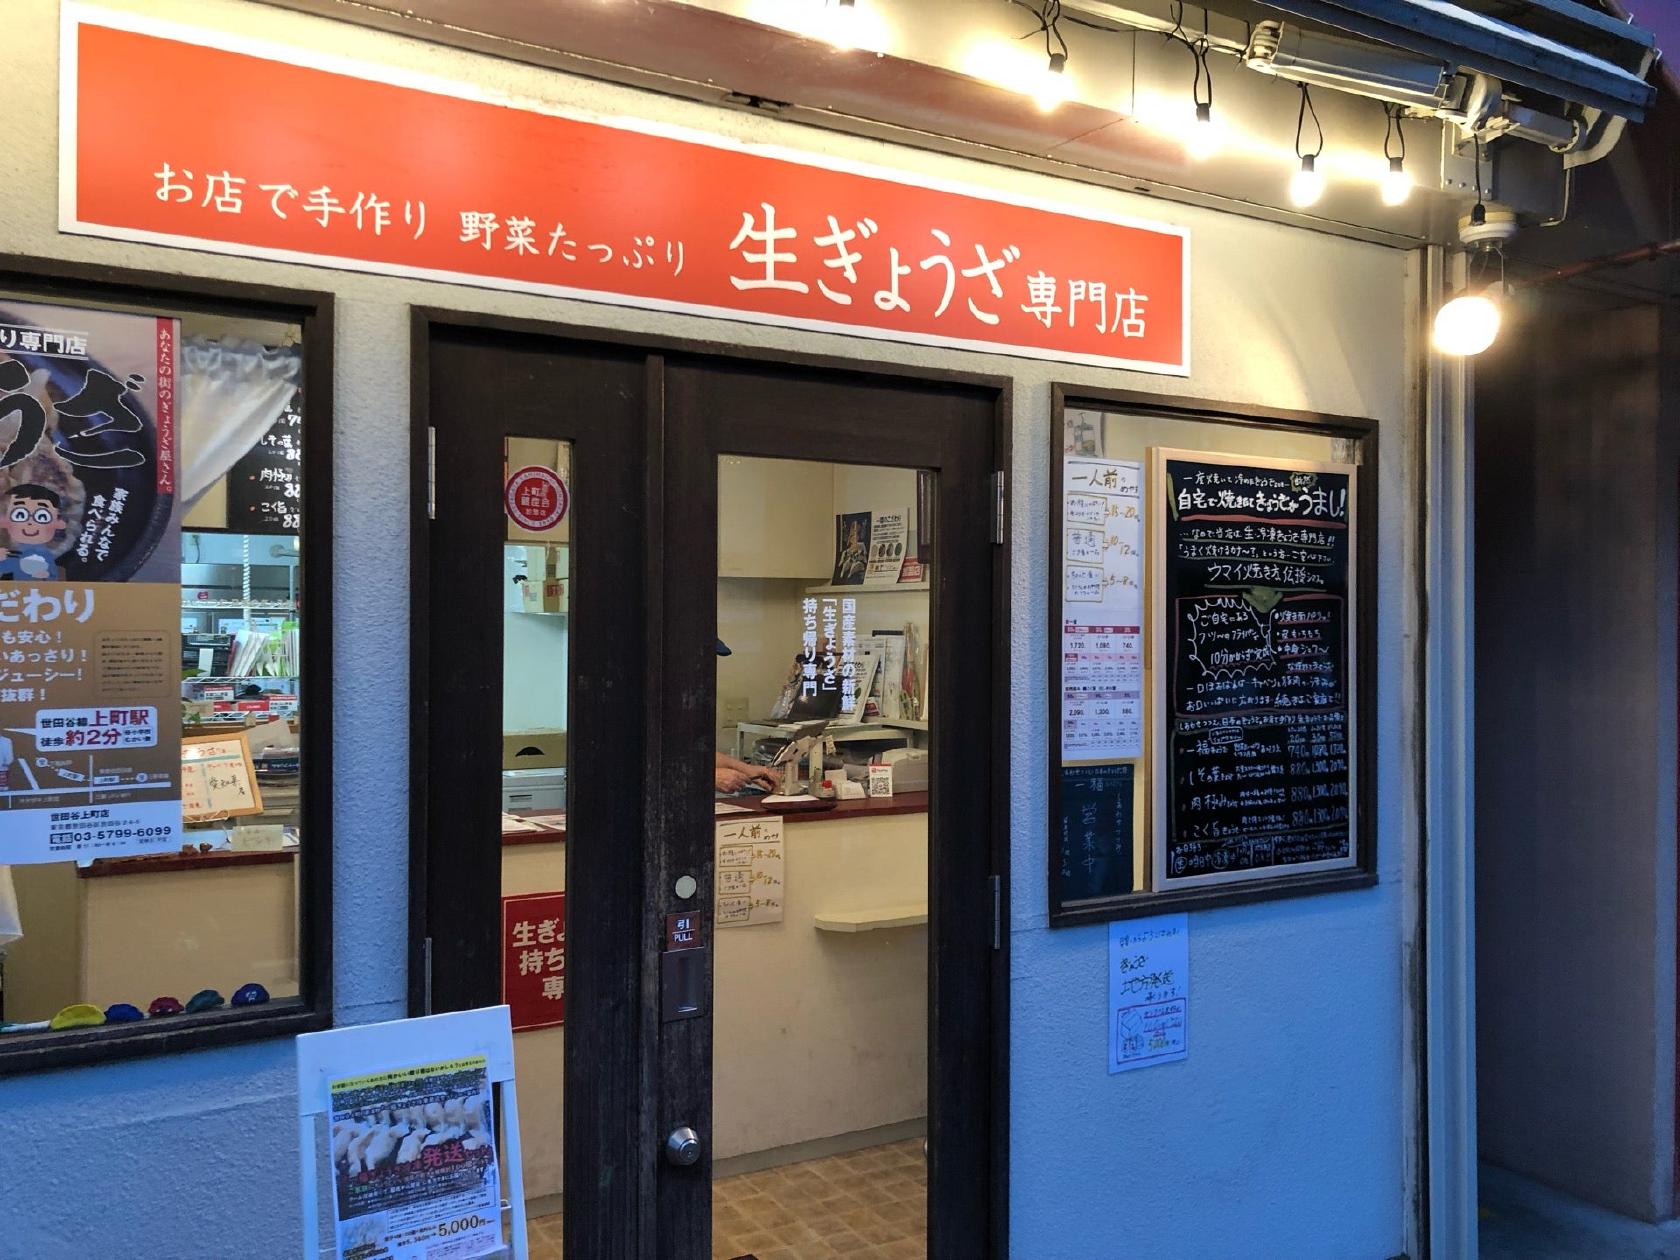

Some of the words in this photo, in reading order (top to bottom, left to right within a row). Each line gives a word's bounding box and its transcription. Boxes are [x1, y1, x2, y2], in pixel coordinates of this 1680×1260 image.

[154, 161, 427, 241] お店で手作り
[459, 209, 685, 278] 野菜たっぷり
[158, 328, 173, 492] あなたの街のぎょうざ屋さん。
[802, 598, 817, 697] 持ち帰り専門
[74, 827, 172, 842] 03-5799-6099
[674, 931, 693, 942] PULL
[677, 919, 690, 930] 引
